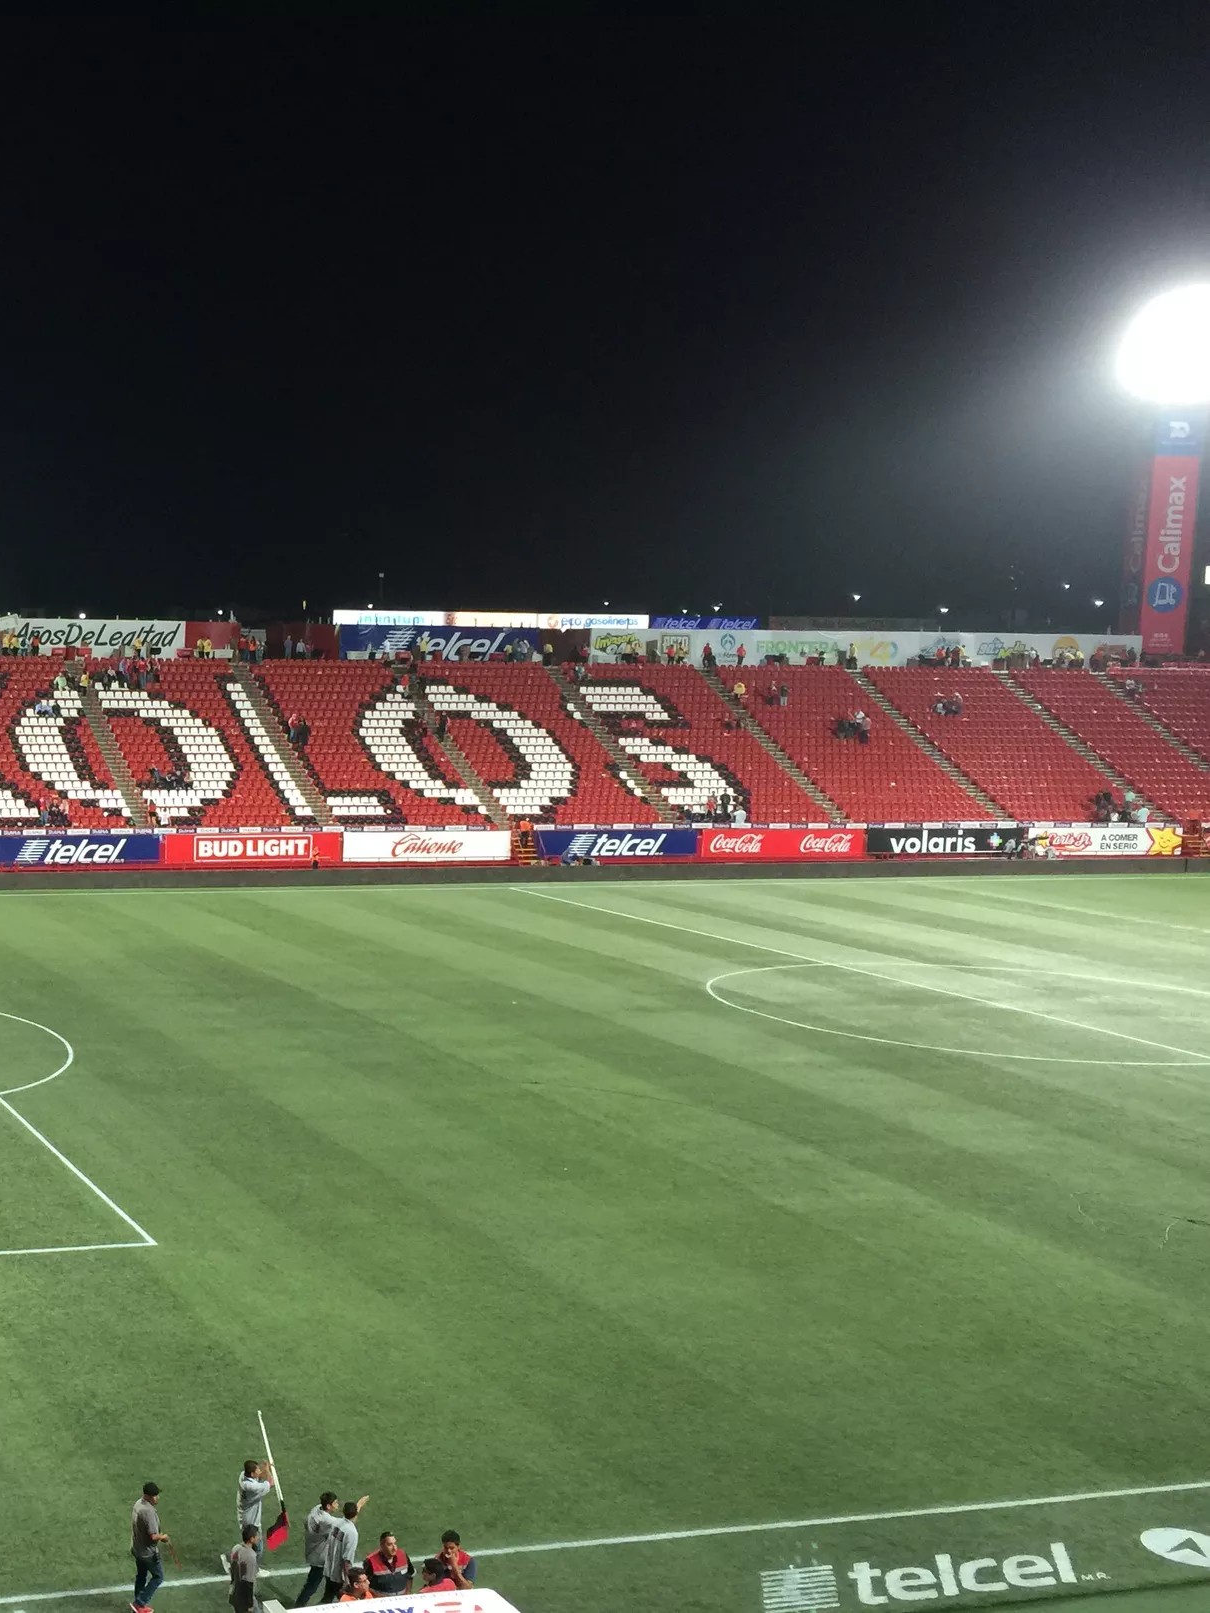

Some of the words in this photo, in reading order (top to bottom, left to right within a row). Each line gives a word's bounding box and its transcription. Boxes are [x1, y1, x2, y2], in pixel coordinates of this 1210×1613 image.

[1157, 475, 1187, 574] Calimax
[664, 616, 703, 629] telcel
[719, 617, 759, 630] telcel
[416, 631, 507, 662] telcel
[756, 640, 840, 654] FRONTERA
[198, 839, 244, 858] BUD
[245, 838, 308, 856] LIGHT
[391, 833, 464, 858] Caliente
[591, 833, 668, 857] telcel
[710, 833, 766, 854] Coca-Cola
[800, 833, 855, 854] Coca-Cola
[890, 829, 976, 854] volaris
[1100, 834, 1107, 842] A
[1108, 834, 1139, 842] COMER
[44, 838, 128, 865] telcel
[847, 1541, 1078, 1606] telcel
